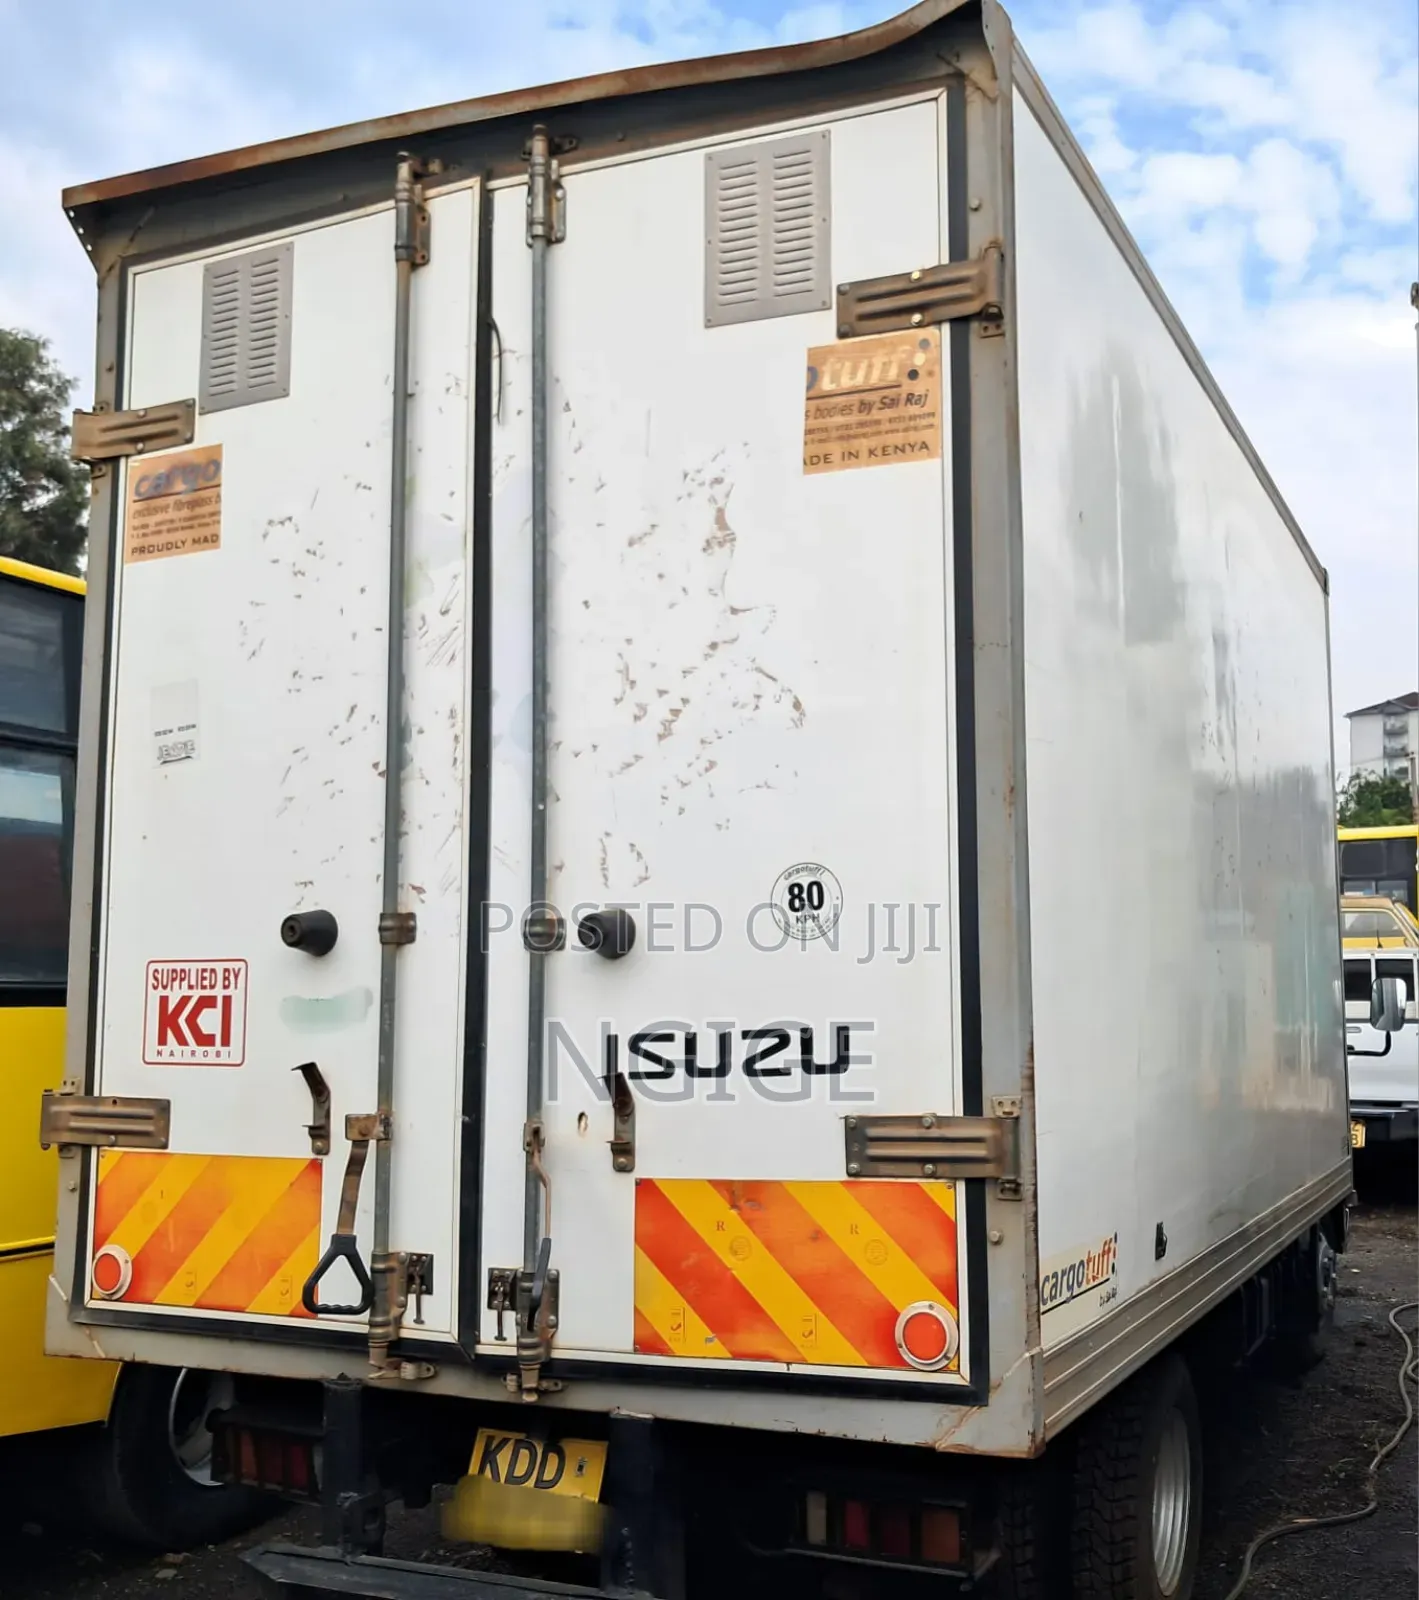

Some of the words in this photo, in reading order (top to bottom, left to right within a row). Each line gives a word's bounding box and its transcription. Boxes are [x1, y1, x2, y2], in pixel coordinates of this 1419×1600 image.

[813, 402, 855, 420] bodies
[857, 398, 876, 416] by
[878, 393, 902, 411] Sai
[904, 388, 930, 408] Raj
[841, 450, 860, 462] IN
[868, 440, 930, 459] KENYA
[134, 458, 221, 497] cargo
[131, 538, 188, 556] PROUDLY
[191, 533, 220, 547] MAD
[787, 880, 825, 913] 80
[795, 912, 820, 925] KPH
[151, 967, 218, 992] SUPPLIED
[222, 967, 242, 990] BY
[157, 995, 233, 1047] KCI
[156, 1049, 232, 1059] NAIROBI
[606, 1025, 851, 1080] ISUZU
[477, 1434, 566, 1490] KDD
